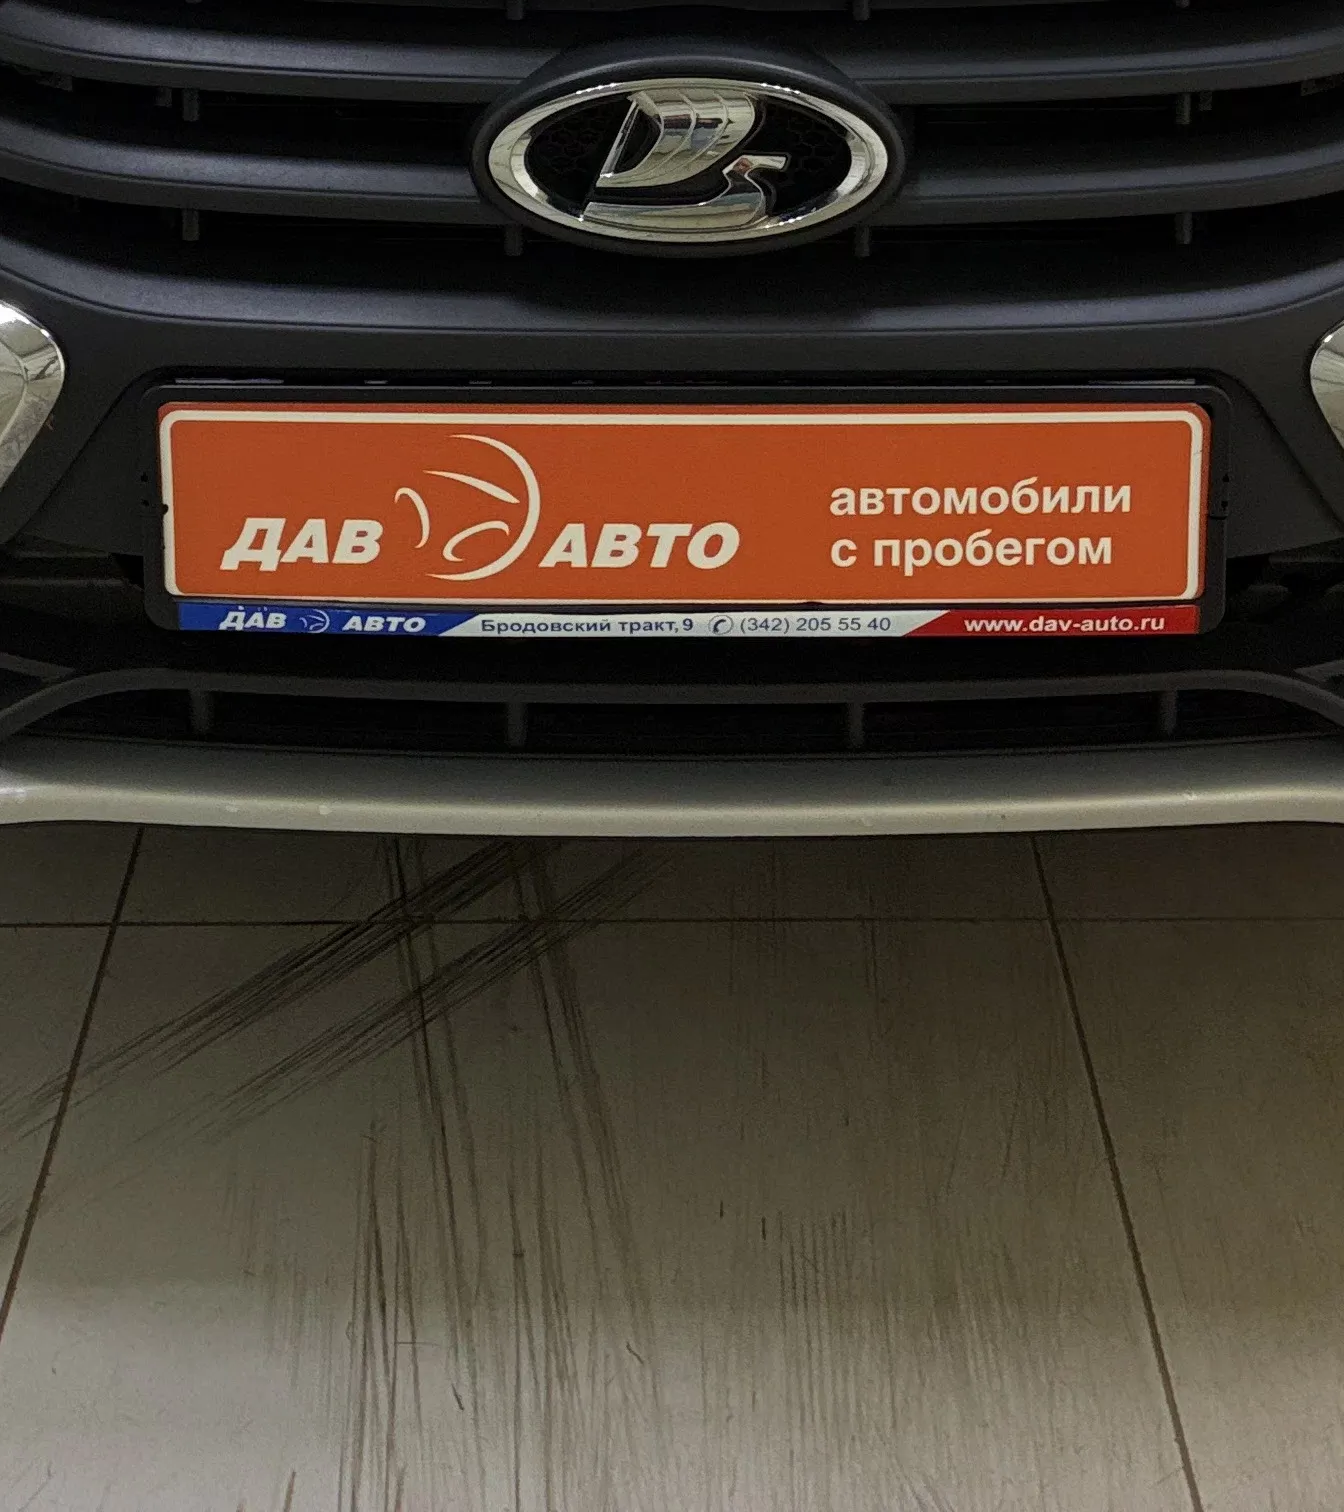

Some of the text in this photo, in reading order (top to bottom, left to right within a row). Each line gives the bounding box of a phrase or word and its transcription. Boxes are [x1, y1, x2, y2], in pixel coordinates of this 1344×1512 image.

[829, 476, 1132, 516] автомобили
[219, 517, 741, 571] ДАВ АВТО
[830, 529, 1113, 576] с пробегом
[219, 609, 426, 633] ДАВ АВТО
[480, 617, 611, 635] Бродовский
[740, 616, 790, 635] (342)
[795, 616, 832, 633] 205
[837, 616, 862, 632] 55
[867, 616, 892, 632] 40
[963, 614, 1165, 633] www.dav-auto.ru
